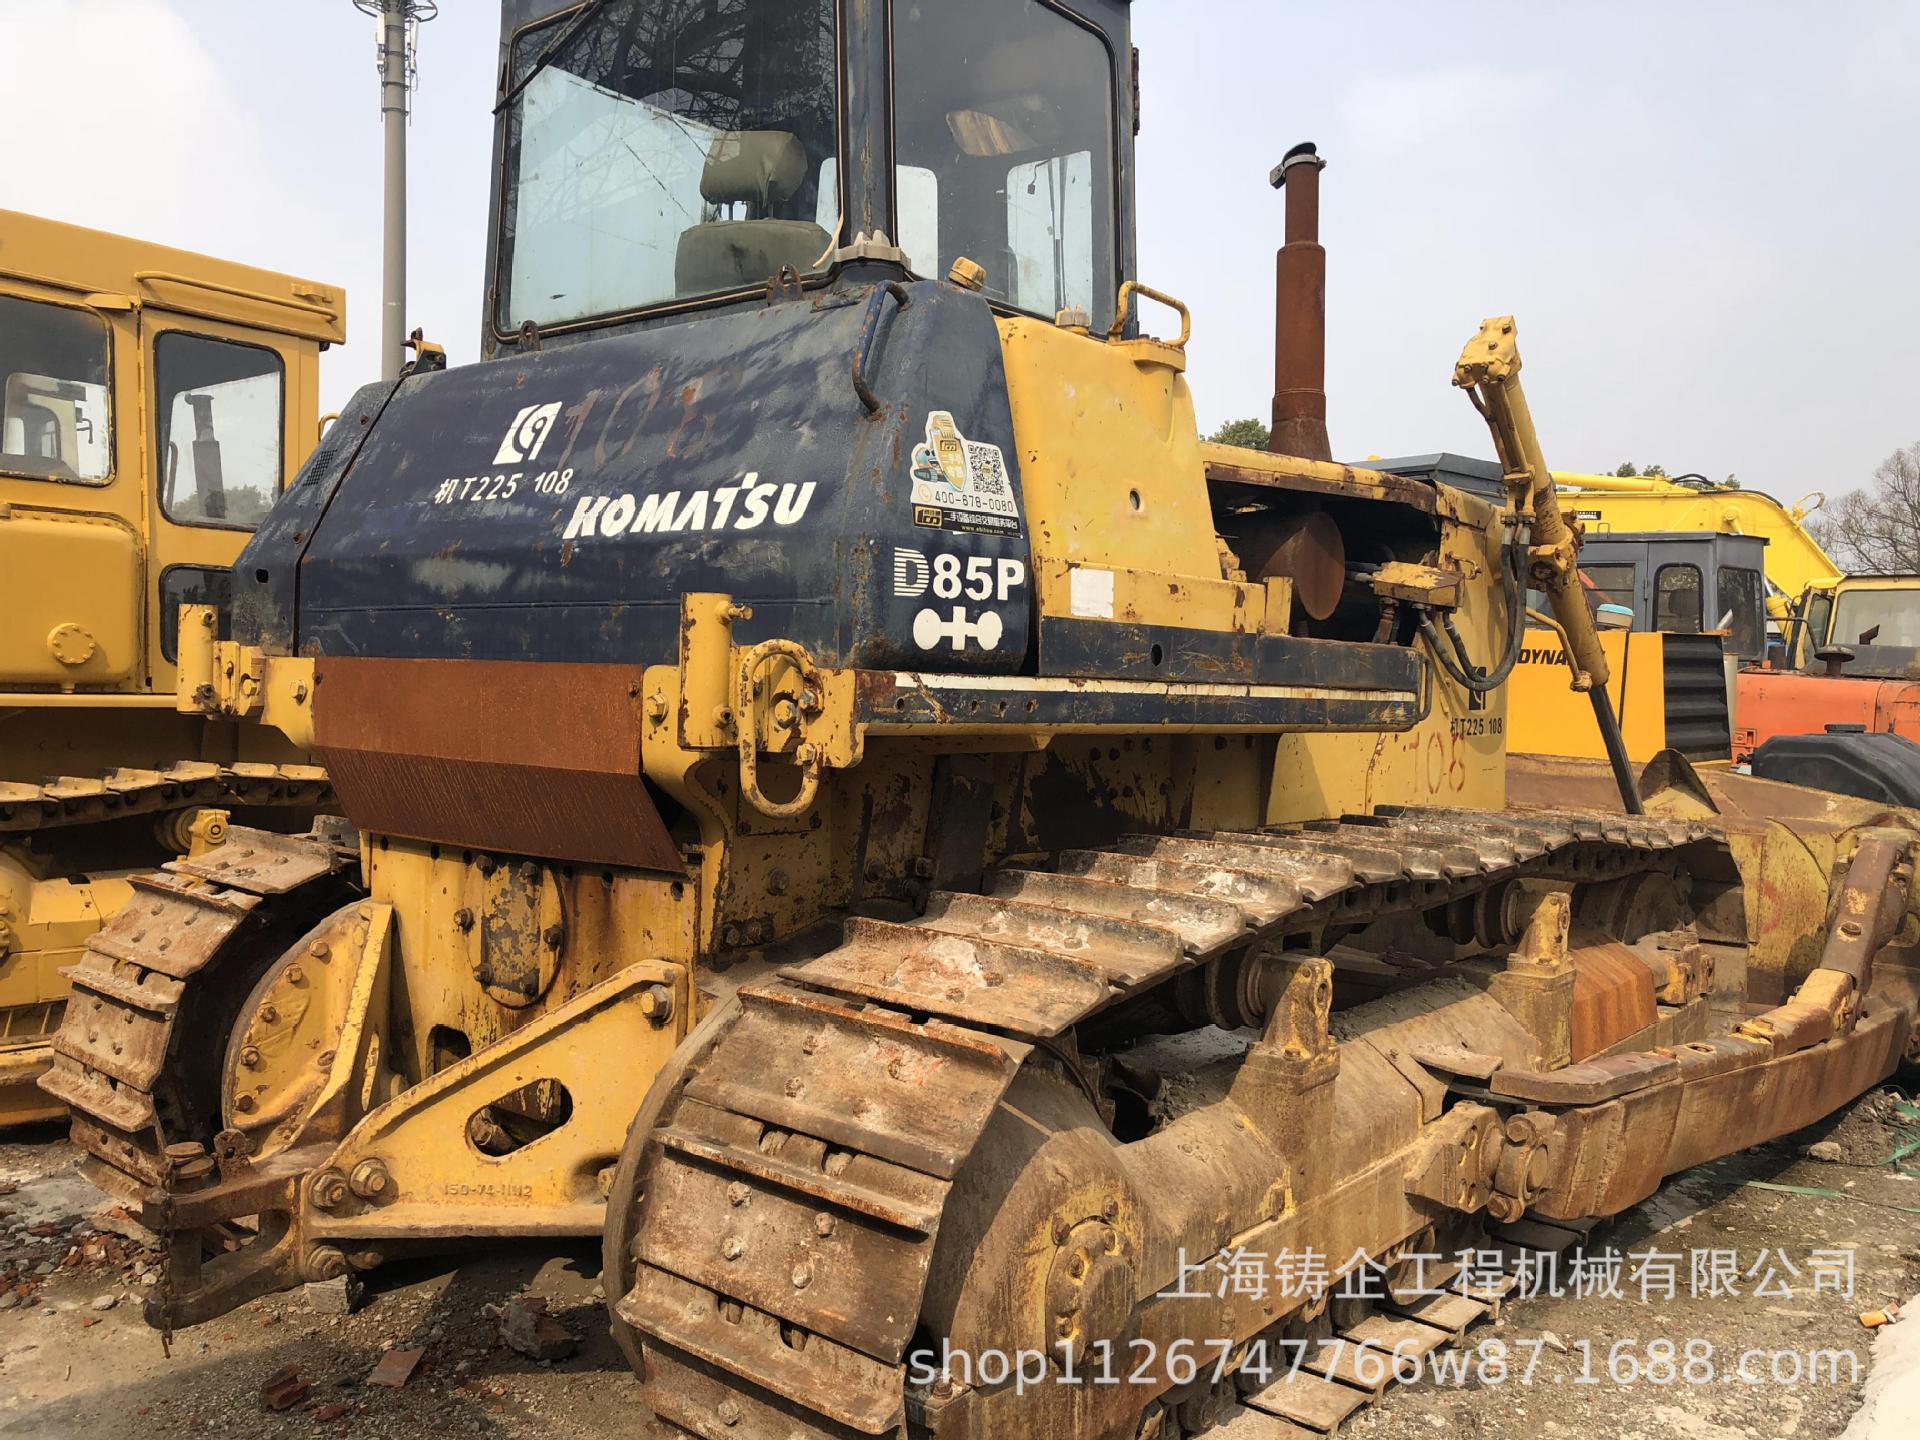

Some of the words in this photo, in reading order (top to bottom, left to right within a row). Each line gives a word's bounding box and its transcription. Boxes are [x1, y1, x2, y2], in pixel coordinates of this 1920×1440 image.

[534, 469, 573, 495] 108
[935, 490, 1014, 513] 400-678-0080
[563, 472, 816, 539] KOMATSU
[894, 547, 1025, 601] D85P
[1489, 717, 1502, 735] 108
[1408, 731, 1466, 794] 108
